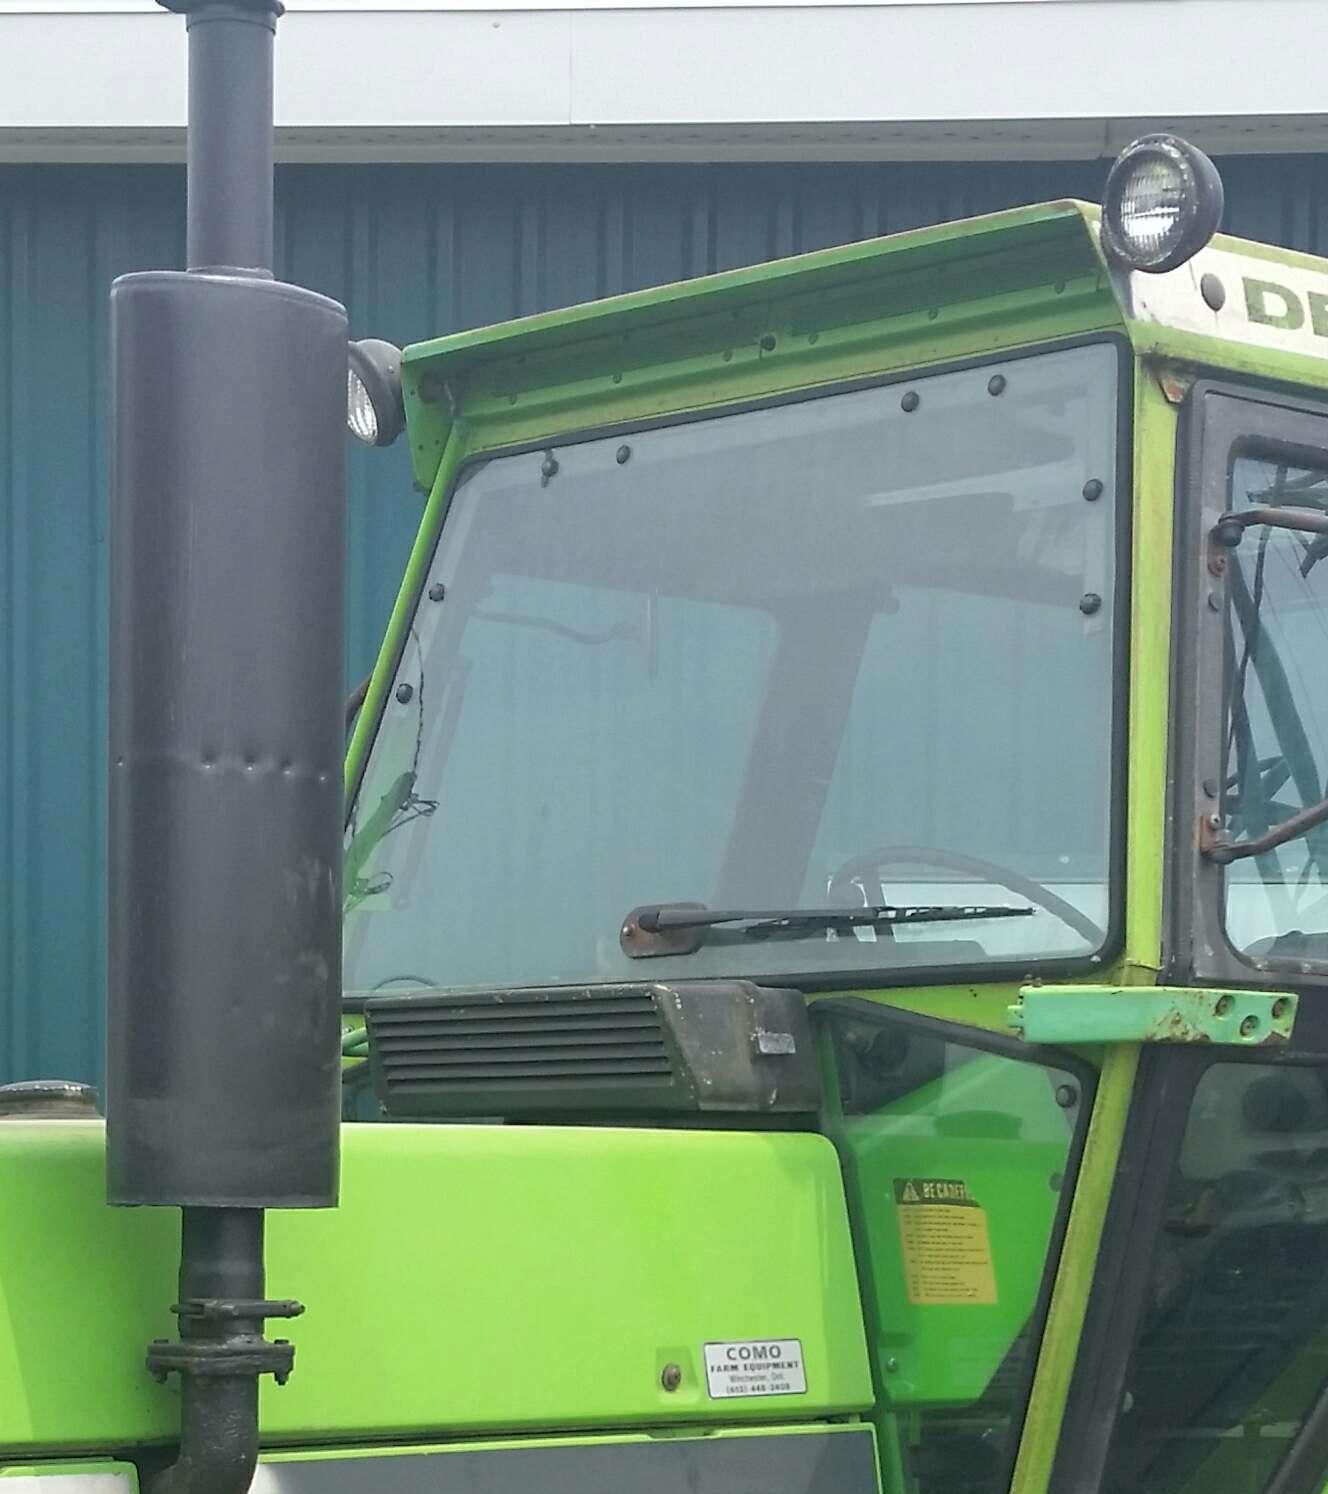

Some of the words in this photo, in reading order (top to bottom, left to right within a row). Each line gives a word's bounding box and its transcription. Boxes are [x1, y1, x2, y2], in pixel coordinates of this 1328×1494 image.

[726, 1345, 781, 1361] COMO
[711, 1363, 739, 1373] FARM
[743, 1360, 798, 1372] EQUIPMENT
